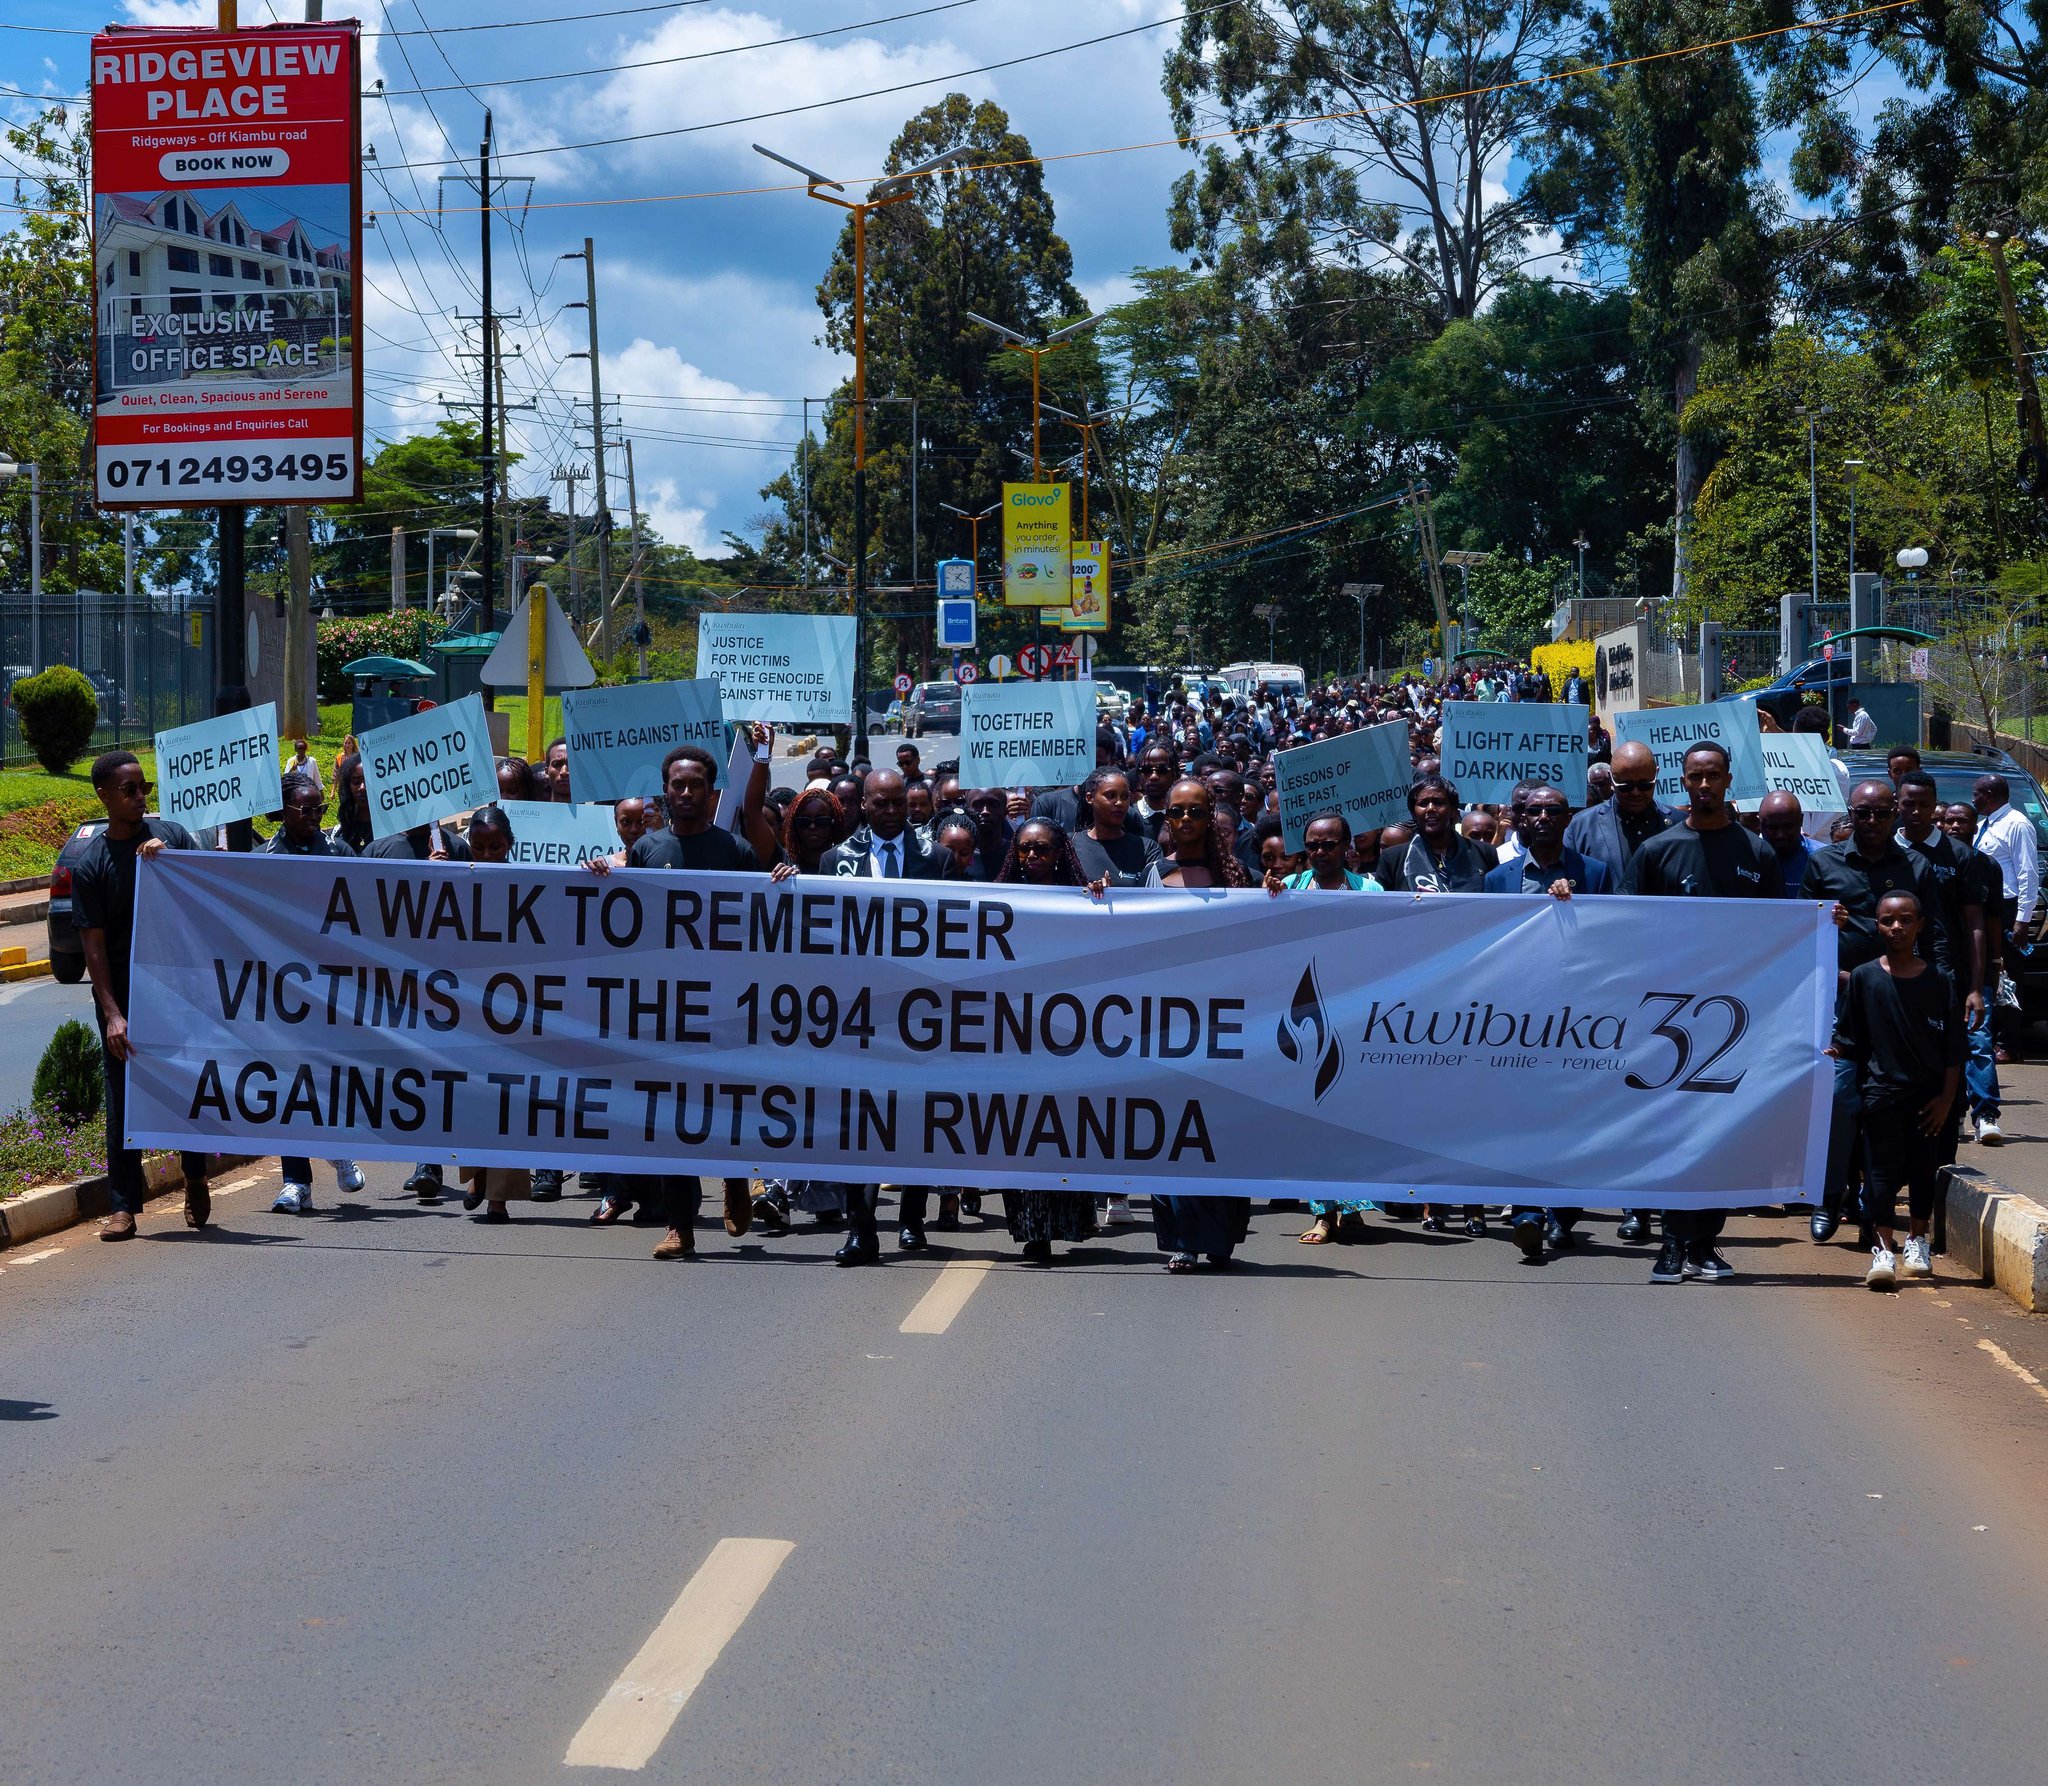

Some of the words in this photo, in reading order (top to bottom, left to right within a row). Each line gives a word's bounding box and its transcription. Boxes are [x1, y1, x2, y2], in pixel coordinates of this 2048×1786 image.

[95, 45, 340, 84] RIDGEVIEW
[147, 85, 288, 120] PLACE
[131, 135, 197, 148] Ridgeways
[208, 132, 226, 143] Off
[229, 130, 276, 142] Kiambu
[279, 129, 307, 140] road
[175, 157, 225, 172] BOOK
[232, 155, 273, 169] NOW
[131, 309, 275, 337] EXCLUSIVE
[131, 346, 224, 372] OFFICE
[232, 343, 319, 367] SPACE
[121, 394, 157, 406] Quiet,
[160, 392, 198, 405] Clean,
[201, 390, 256, 403] Spacious
[258, 390, 282, 401] and
[284, 388, 328, 400] Serene
[143, 423, 161, 434] For
[164, 421, 211, 434] Bookings
[213, 420, 233, 431] and
[235, 418, 285, 431] Enquiries
[288, 418, 309, 429] Call
[107, 453, 348, 488] 0712493495
[1011, 493, 1054, 506] Glovo
[1016, 521, 1058, 530] Anything
[1015, 545, 1022, 553] in
[1024, 545, 1060, 553] minutes!
[1016, 535, 1031, 543] you
[712, 637, 764, 648] JUSTICE
[711, 654, 737, 665] FOR
[741, 655, 790, 666] VICTIMS
[731, 671, 755, 683] THE
[759, 673, 824, 685] GENOCIDE
[720, 689, 764, 701] GAINST
[768, 690, 792, 701] THE
[797, 691, 831, 702] TUTSI
[972, 712, 1053, 731] TOGETHER
[571, 731, 613, 751] UNITE
[617, 724, 679, 747] AGAINST
[684, 720, 721, 740] HATE
[1455, 731, 1513, 750] LIGHT
[1518, 733, 1583, 753] AFTER
[1650, 722, 1720, 744] HEALING
[169, 748, 214, 779] HOPE
[218, 733, 270, 767] AFTER
[374, 749, 407, 778] SAY
[412, 740, 438, 767] NO
[441, 731, 466, 756] TO
[971, 741, 994, 759] WE
[999, 738, 1086, 758] REMEMBER
[1281, 766, 1333, 792] LESSONS
[1336, 760, 1351, 778] OF
[1454, 760, 1563, 782] DARKNESS
[171, 777, 242, 814] HORROR
[380, 763, 472, 811] GENOCIDE
[1773, 778, 1832, 795] FORGET
[1283, 796, 1303, 811] THE
[1308, 785, 1339, 805] PAST,
[507, 842, 571, 864] NEVER
[320, 877, 361, 935] A
[376, 878, 547, 945] WALK
[565, 886, 643, 948] TO
[666, 889, 1016, 962] REMEMBER
[213, 958, 461, 1032] VICTIMS
[481, 971, 566, 1036] OF
[587, 976, 711, 1043] THE
[736, 982, 876, 1050] 1994
[898, 986, 1245, 1060] GENOCIDE
[1361, 1001, 1625, 1049] Kwibuka
[1624, 991, 1750, 1094] 32
[1360, 1051, 1467, 1068] remember
[1490, 1053, 1537, 1069] unite
[1562, 1056, 1626, 1071] renew
[188, 1059, 468, 1132] AGAINST
[487, 1072, 612, 1140] THE
[634, 1080, 814, 1149] TUTSI
[839, 1088, 898, 1152] IN
[923, 1092, 1216, 1163] RWANDA
